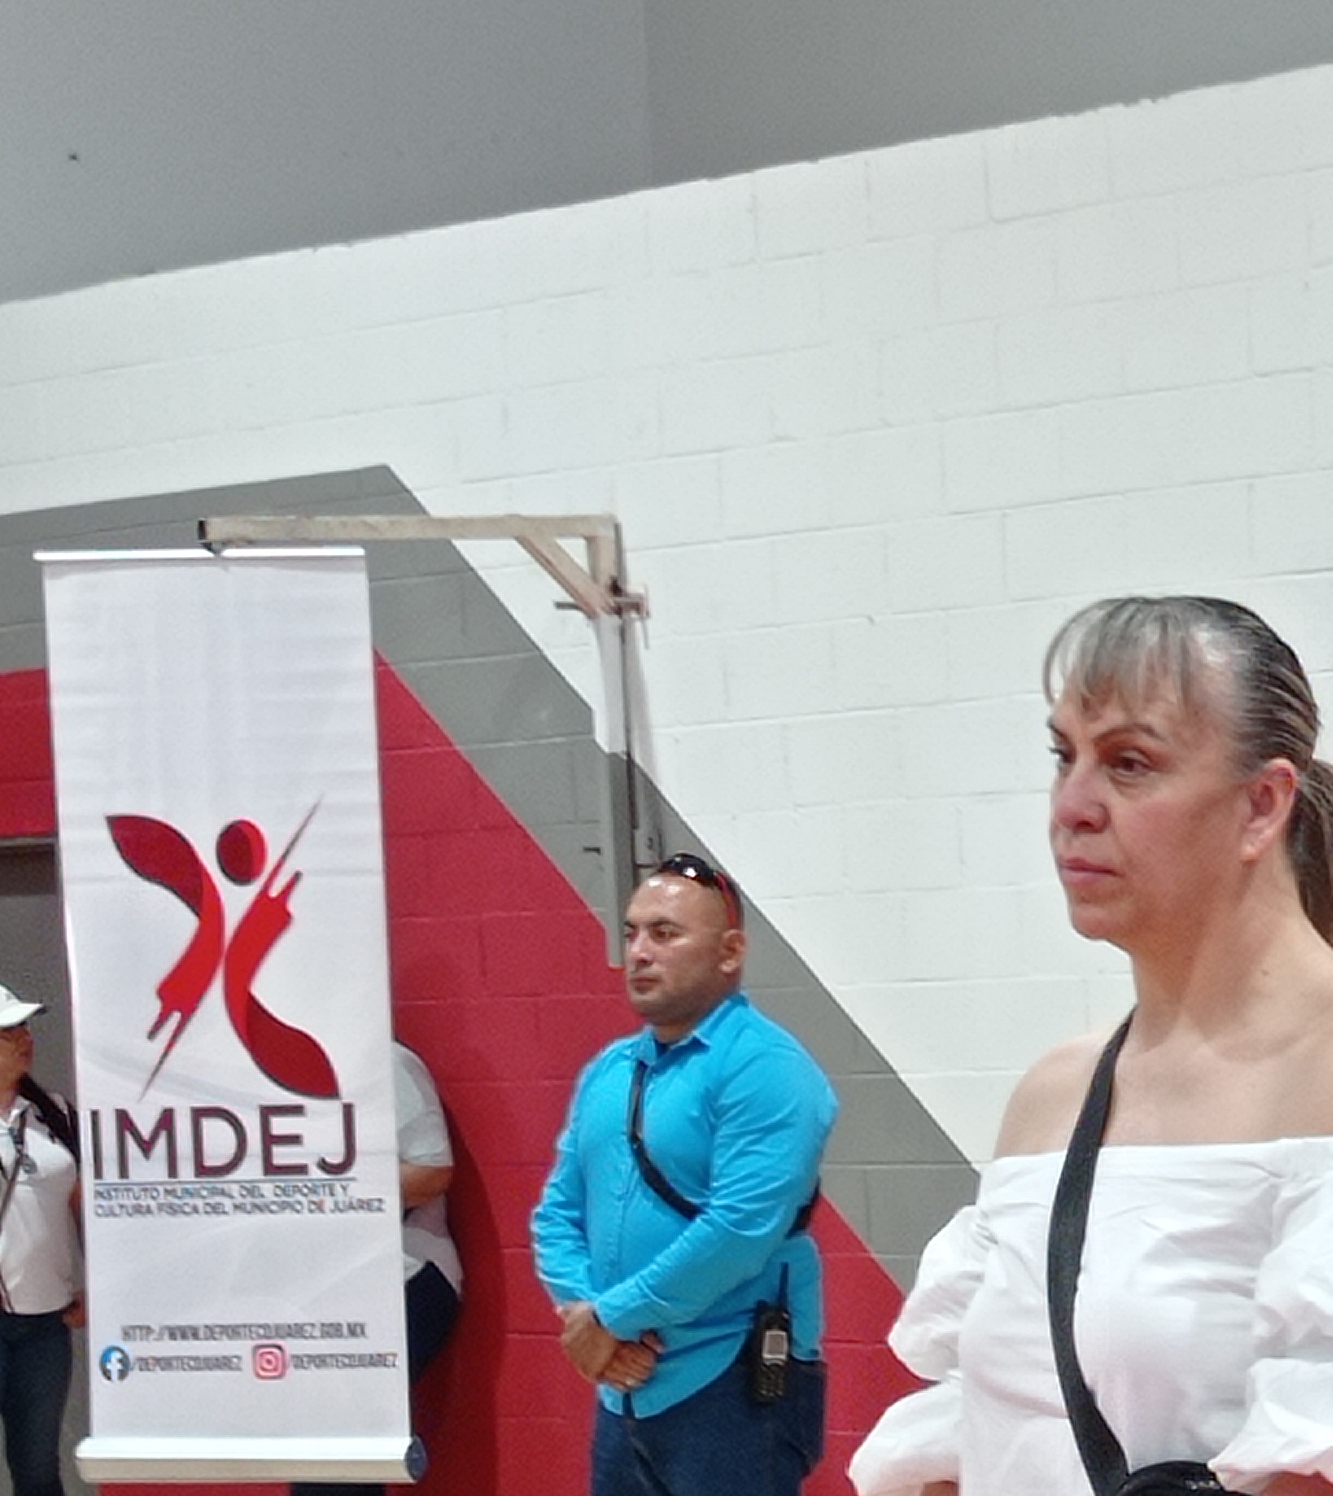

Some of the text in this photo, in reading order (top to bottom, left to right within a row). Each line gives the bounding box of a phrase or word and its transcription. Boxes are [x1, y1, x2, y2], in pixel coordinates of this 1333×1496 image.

[90, 1103, 357, 1180] IMDEJ
[94, 1182, 350, 1200] INSTITUTO MUNICIPAL DEL DEPORTE Y
[94, 1202, 153, 1217] CULTURA
[203, 1201, 230, 1215] DEL
[232, 1200, 304, 1214] MUNICIPIO
[307, 1199, 325, 1214] DE
